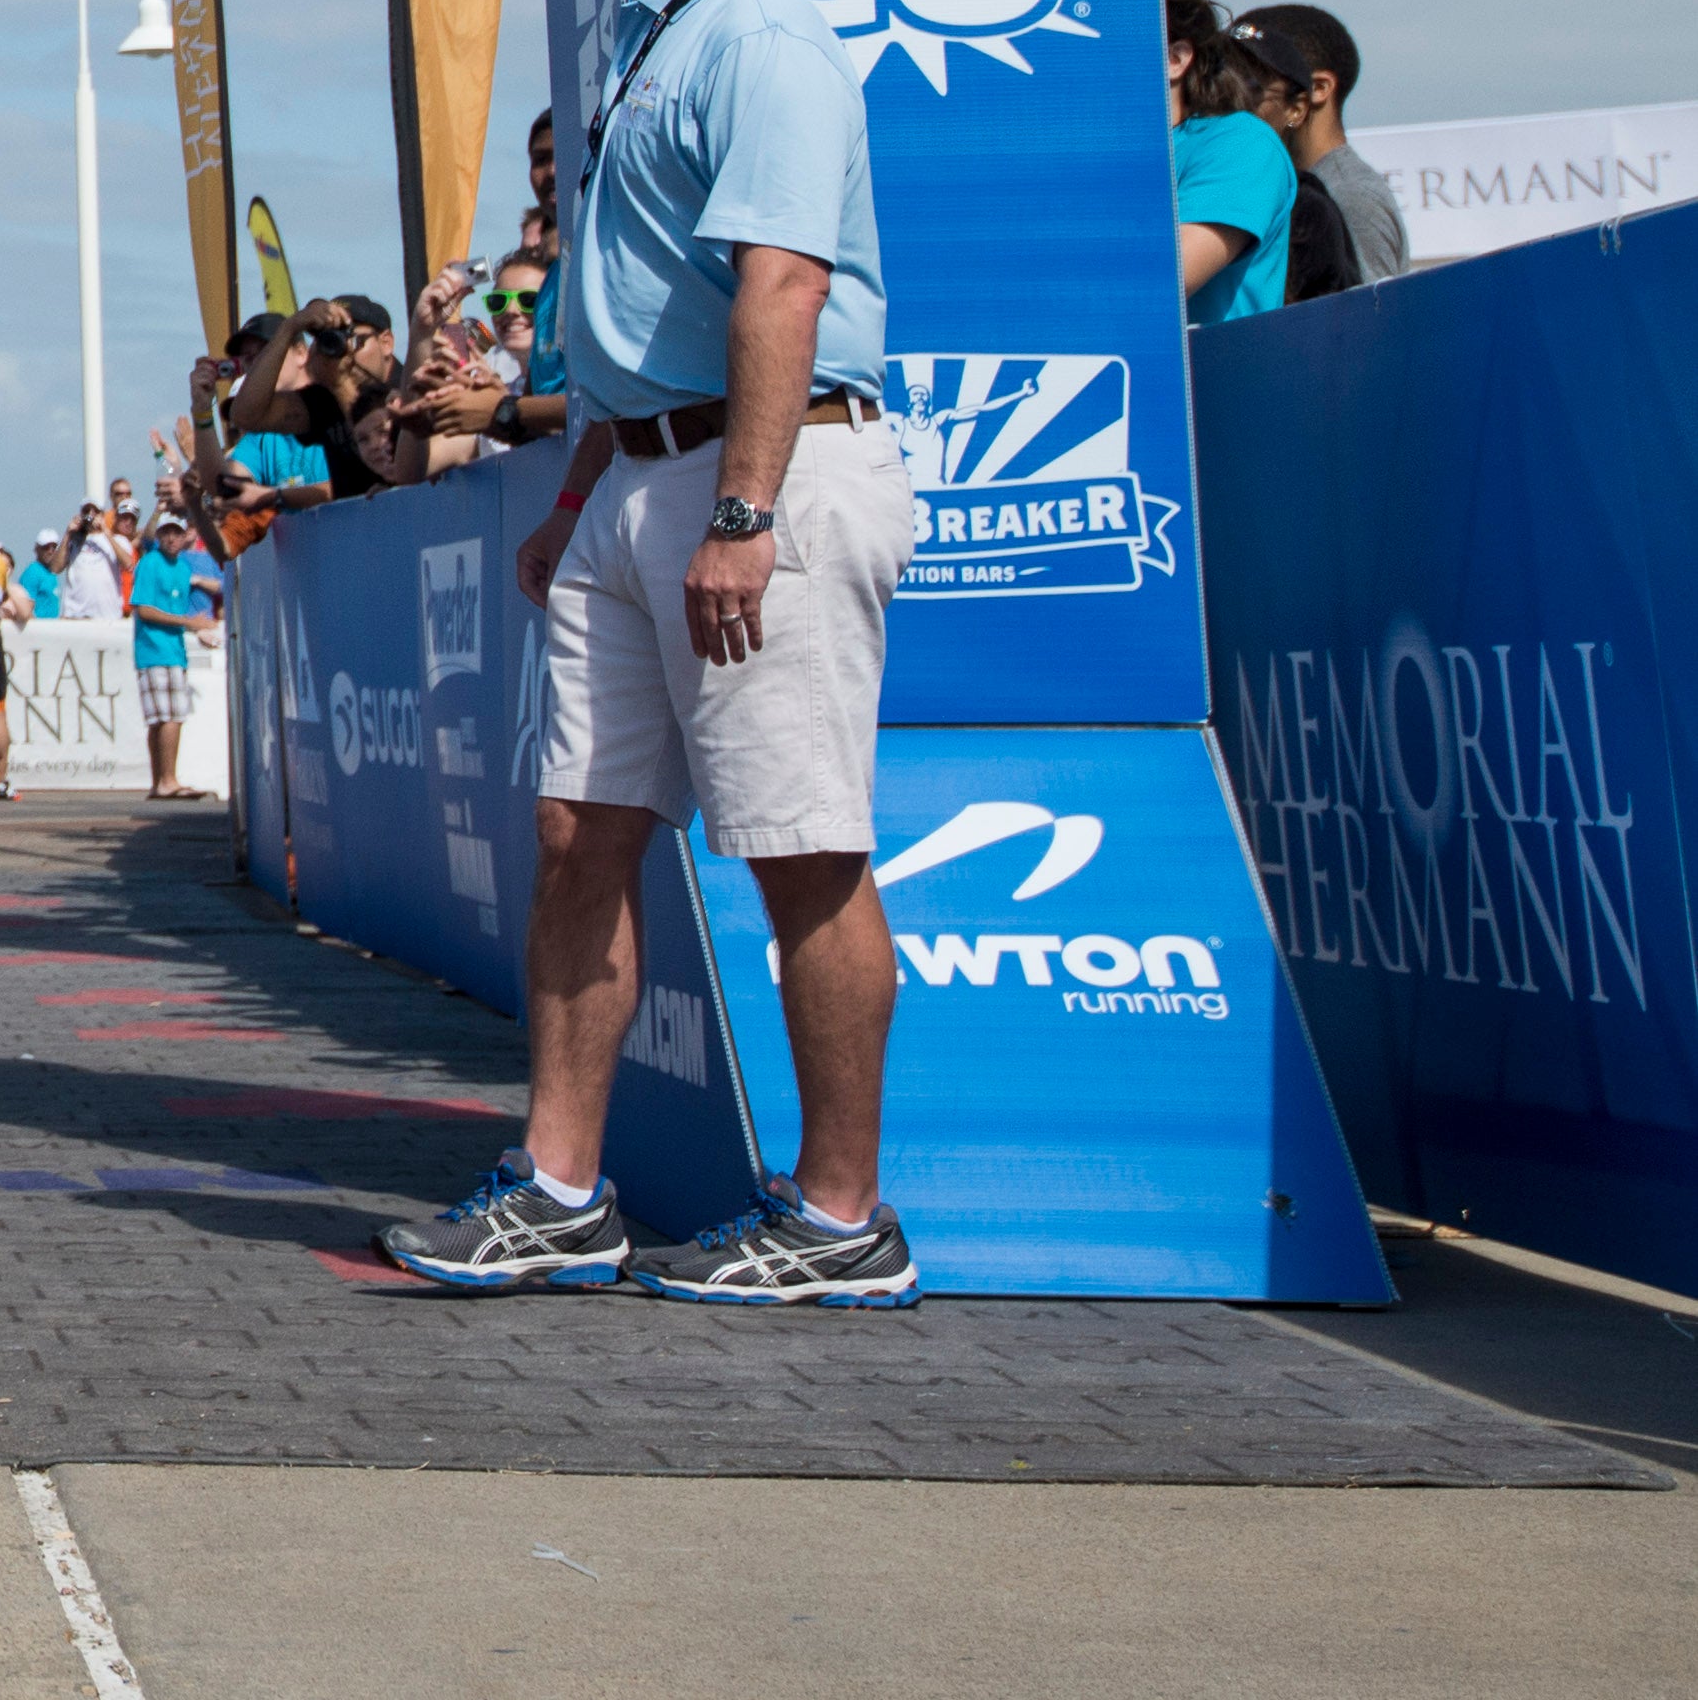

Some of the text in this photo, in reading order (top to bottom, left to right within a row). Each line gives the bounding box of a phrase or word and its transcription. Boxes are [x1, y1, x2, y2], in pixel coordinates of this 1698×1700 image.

[1383, 152, 1658, 211] ERMANN
[961, 565, 1016, 584] BARS
[1236, 641, 1632, 824] MEMORIAL
[767, 933, 1223, 986] WTON
[1062, 986, 1231, 1020] running
